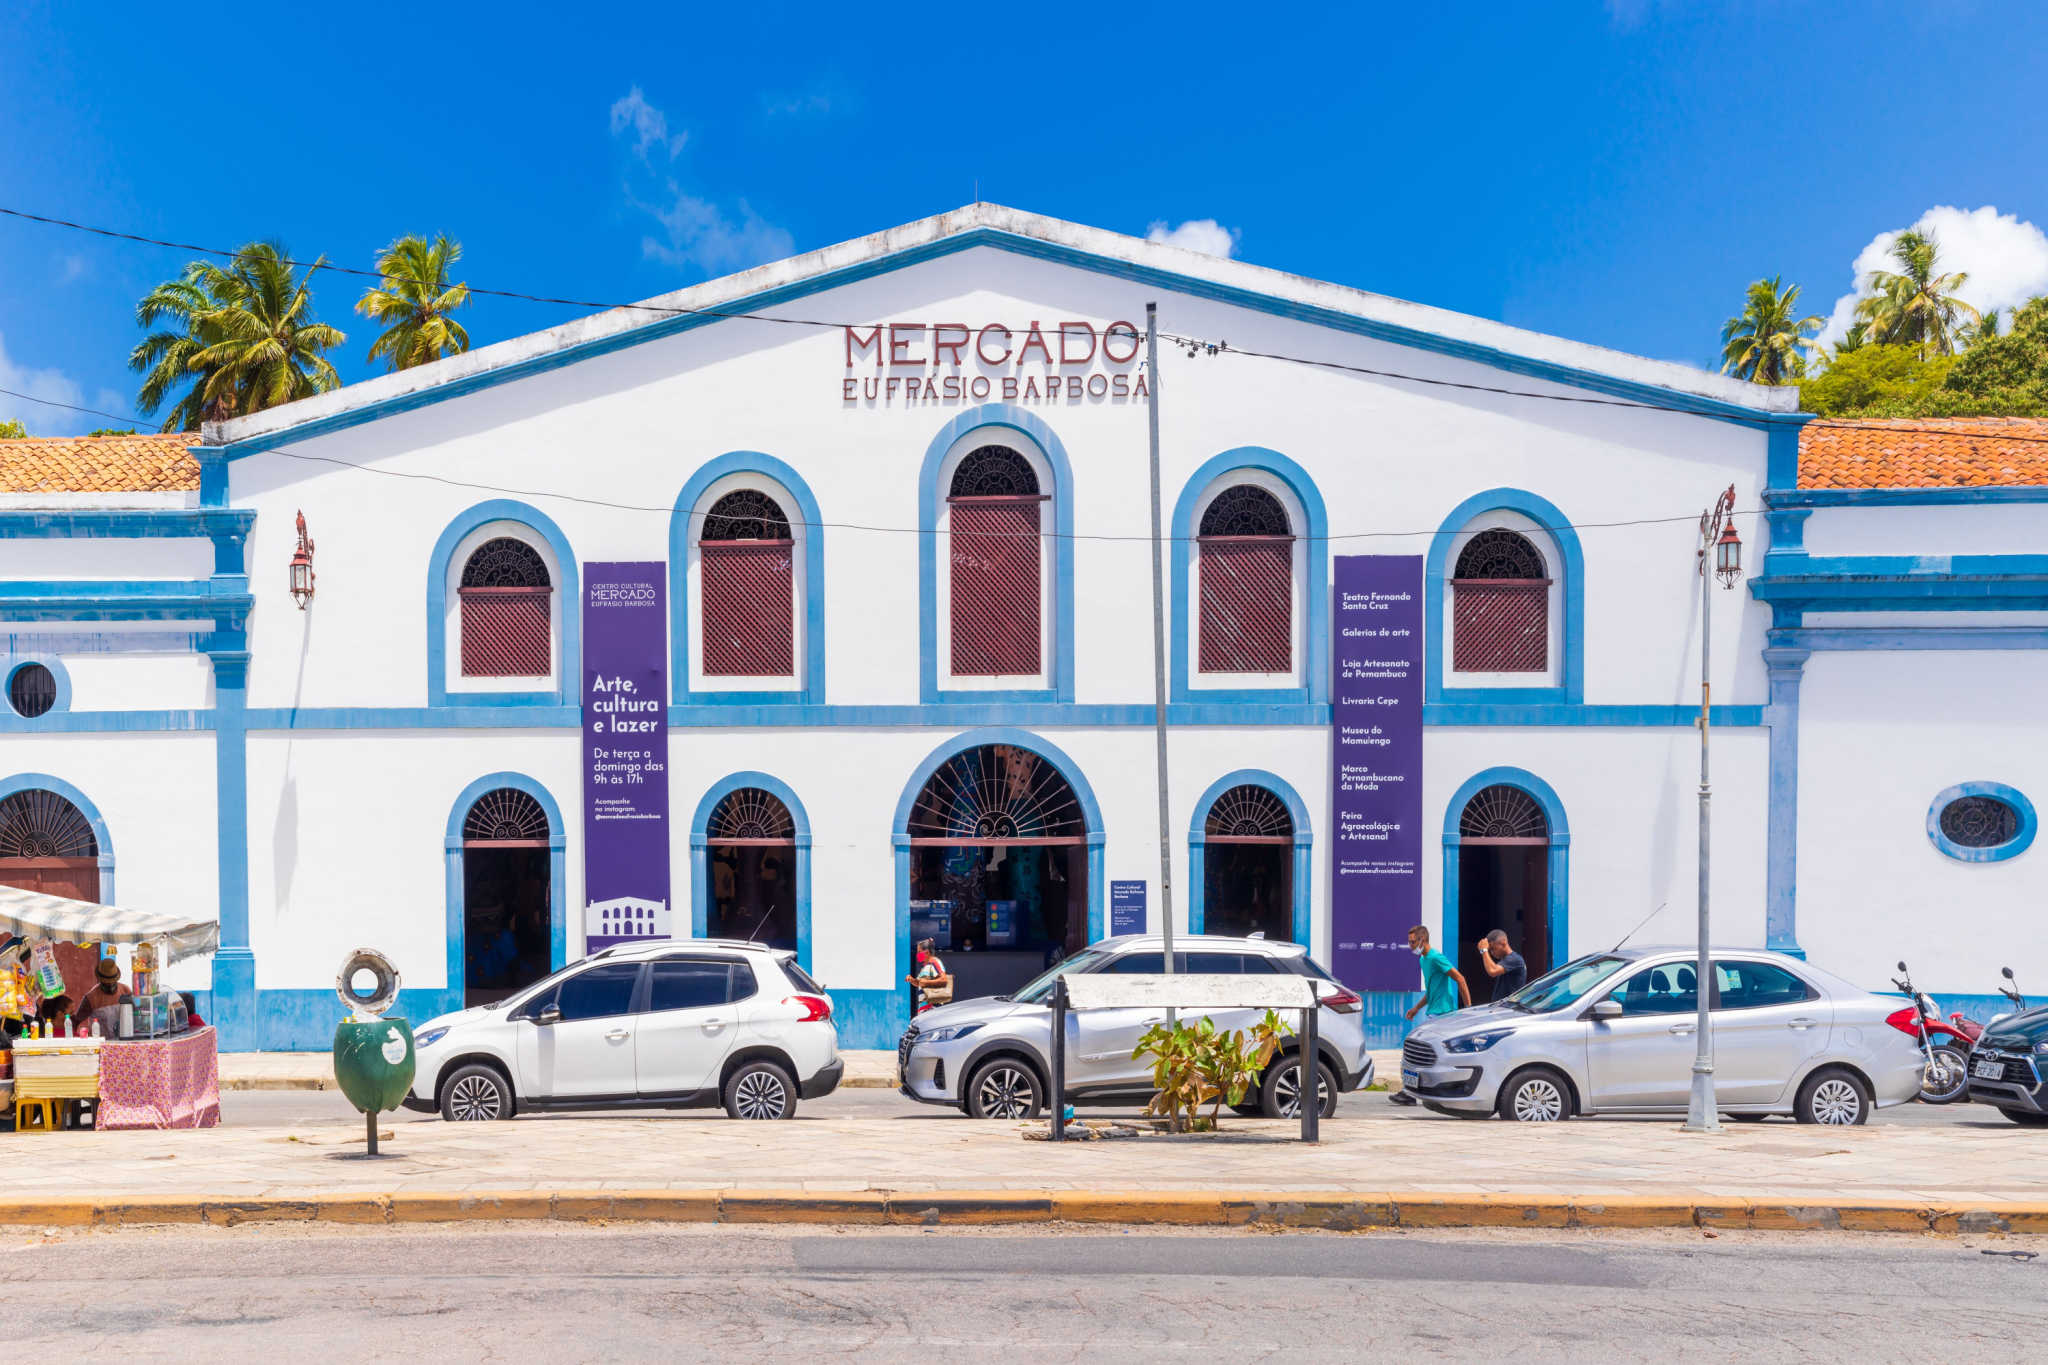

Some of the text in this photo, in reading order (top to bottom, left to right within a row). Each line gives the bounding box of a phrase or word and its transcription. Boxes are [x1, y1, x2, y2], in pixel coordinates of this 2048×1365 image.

[845, 320, 1139, 367] MERCADO
[843, 372, 1149, 401] EUFRÁSIO BARBOSA
[591, 589, 656, 600] MERCADO
[1342, 591, 1411, 601] Teatro Fernando
[1342, 601, 1388, 610] Santa Cruz
[1342, 627, 1410, 637] Galerias de arte
[1342, 659, 1410, 669] Loja Artesanato
[1342, 668, 1406, 678] de Pernambuco
[592, 674, 638, 695] Arte,
[593, 694, 659, 713] cultura
[1342, 696, 1399, 707] Livraria Cepe
[593, 714, 658, 733] e lazer
[1342, 725, 1382, 735] Museu do
[1342, 735, 1391, 747] Mamulengo
[594, 747, 651, 761] De terça a
[594, 759, 664, 773] domingo das
[1342, 764, 1369, 773] Marco
[594, 772, 643, 784] 9h às 17h
[1341, 772, 1405, 782] Pernambucano
[1341, 781, 1379, 791] da Moda
[1341, 810, 1363, 820] Feira
[1341, 820, 1401, 832] Agroecológica
[1348, 832, 1389, 841] Artesanal
